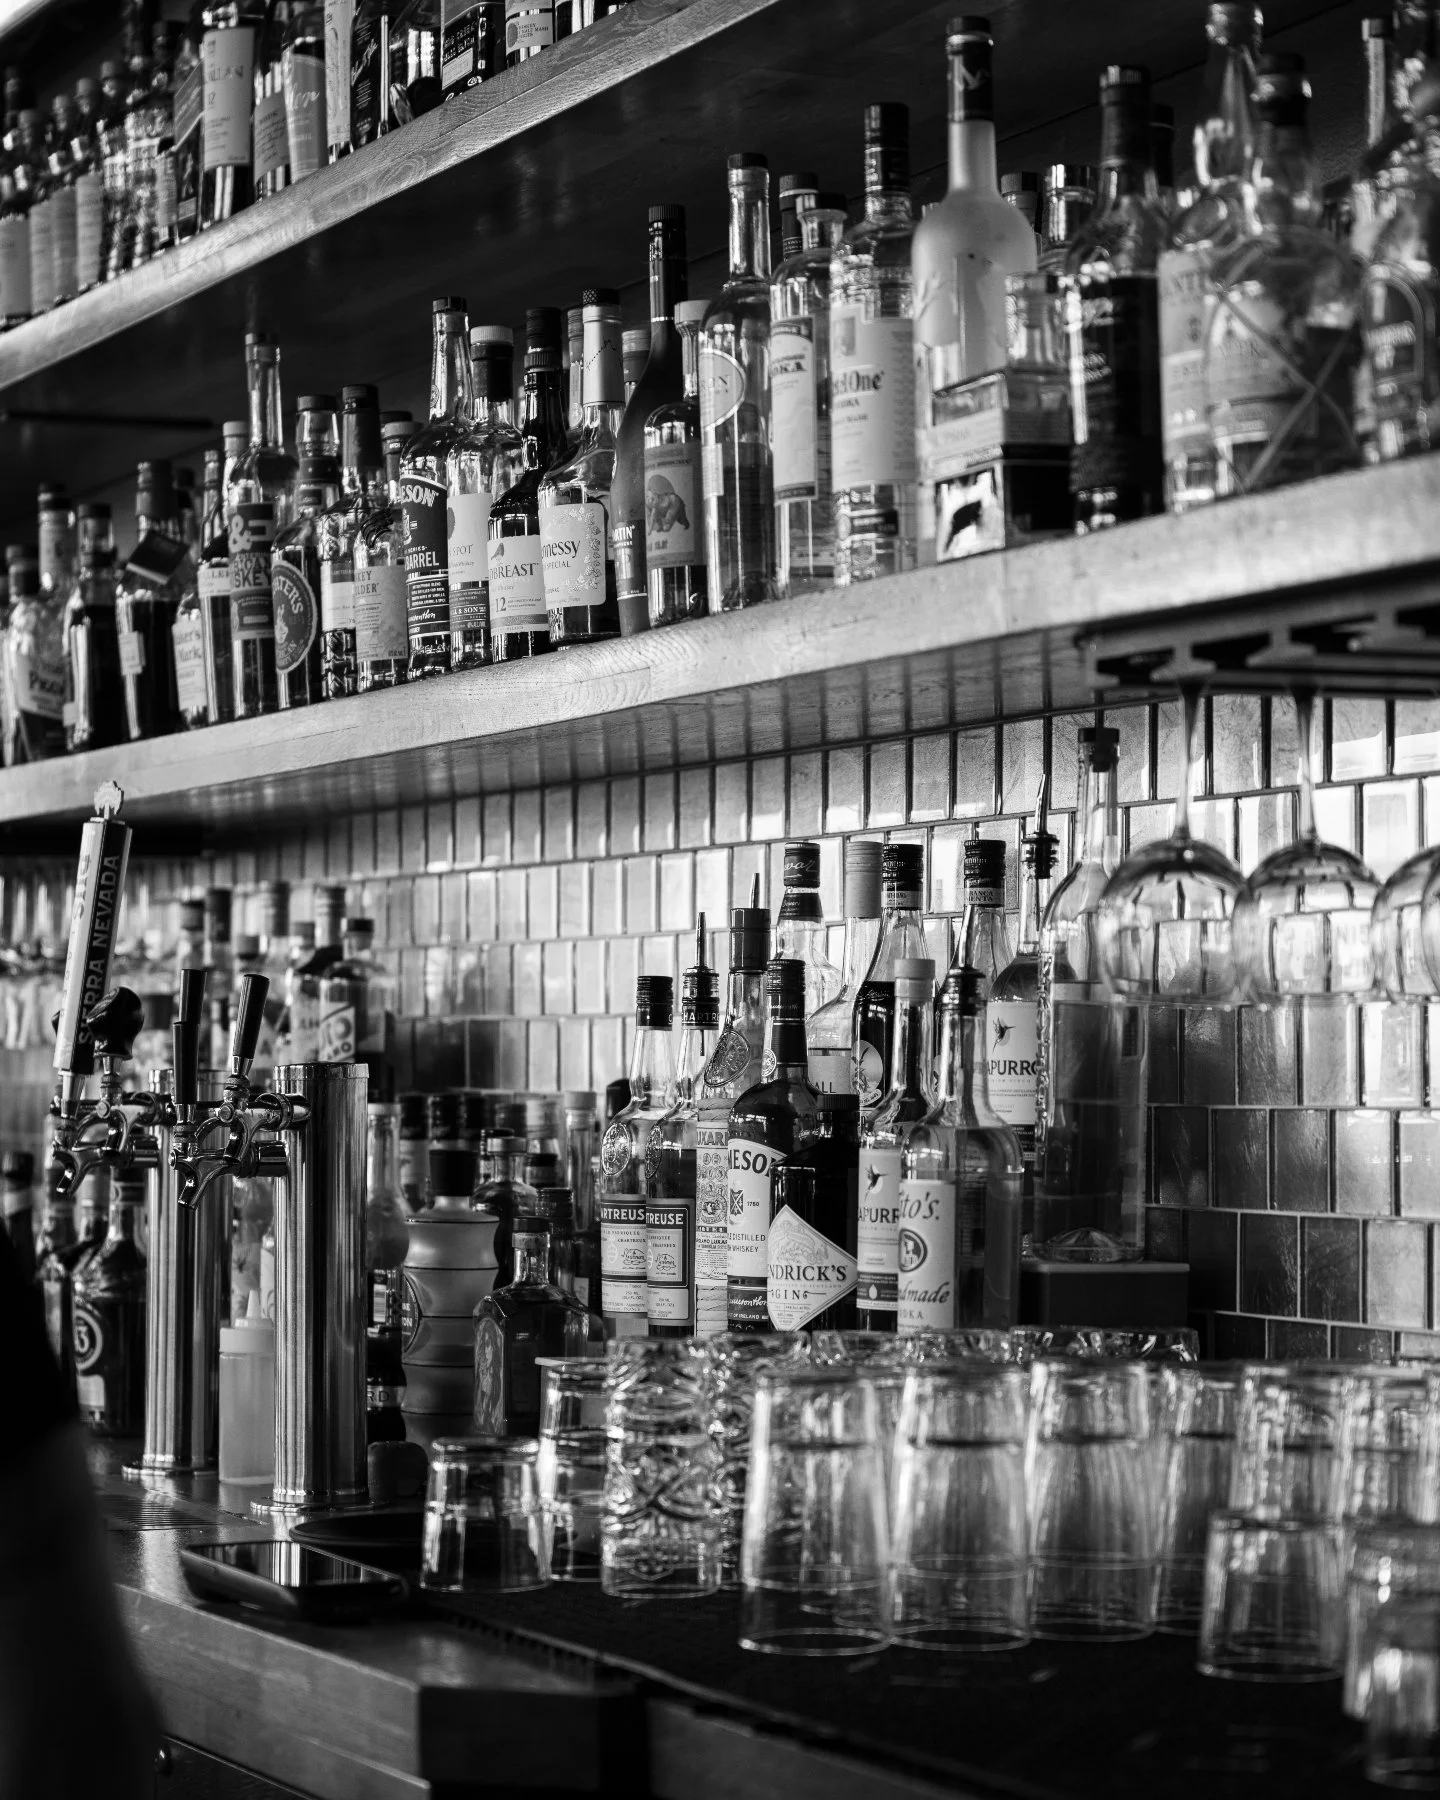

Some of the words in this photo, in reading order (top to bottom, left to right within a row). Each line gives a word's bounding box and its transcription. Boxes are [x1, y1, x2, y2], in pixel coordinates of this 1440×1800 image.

[496, 597, 507, 612] 12
[92, 855, 120, 949] NEVADA
[732, 1244, 759, 1253] WHISKEY
[775, 1289, 801, 1300] GIN
